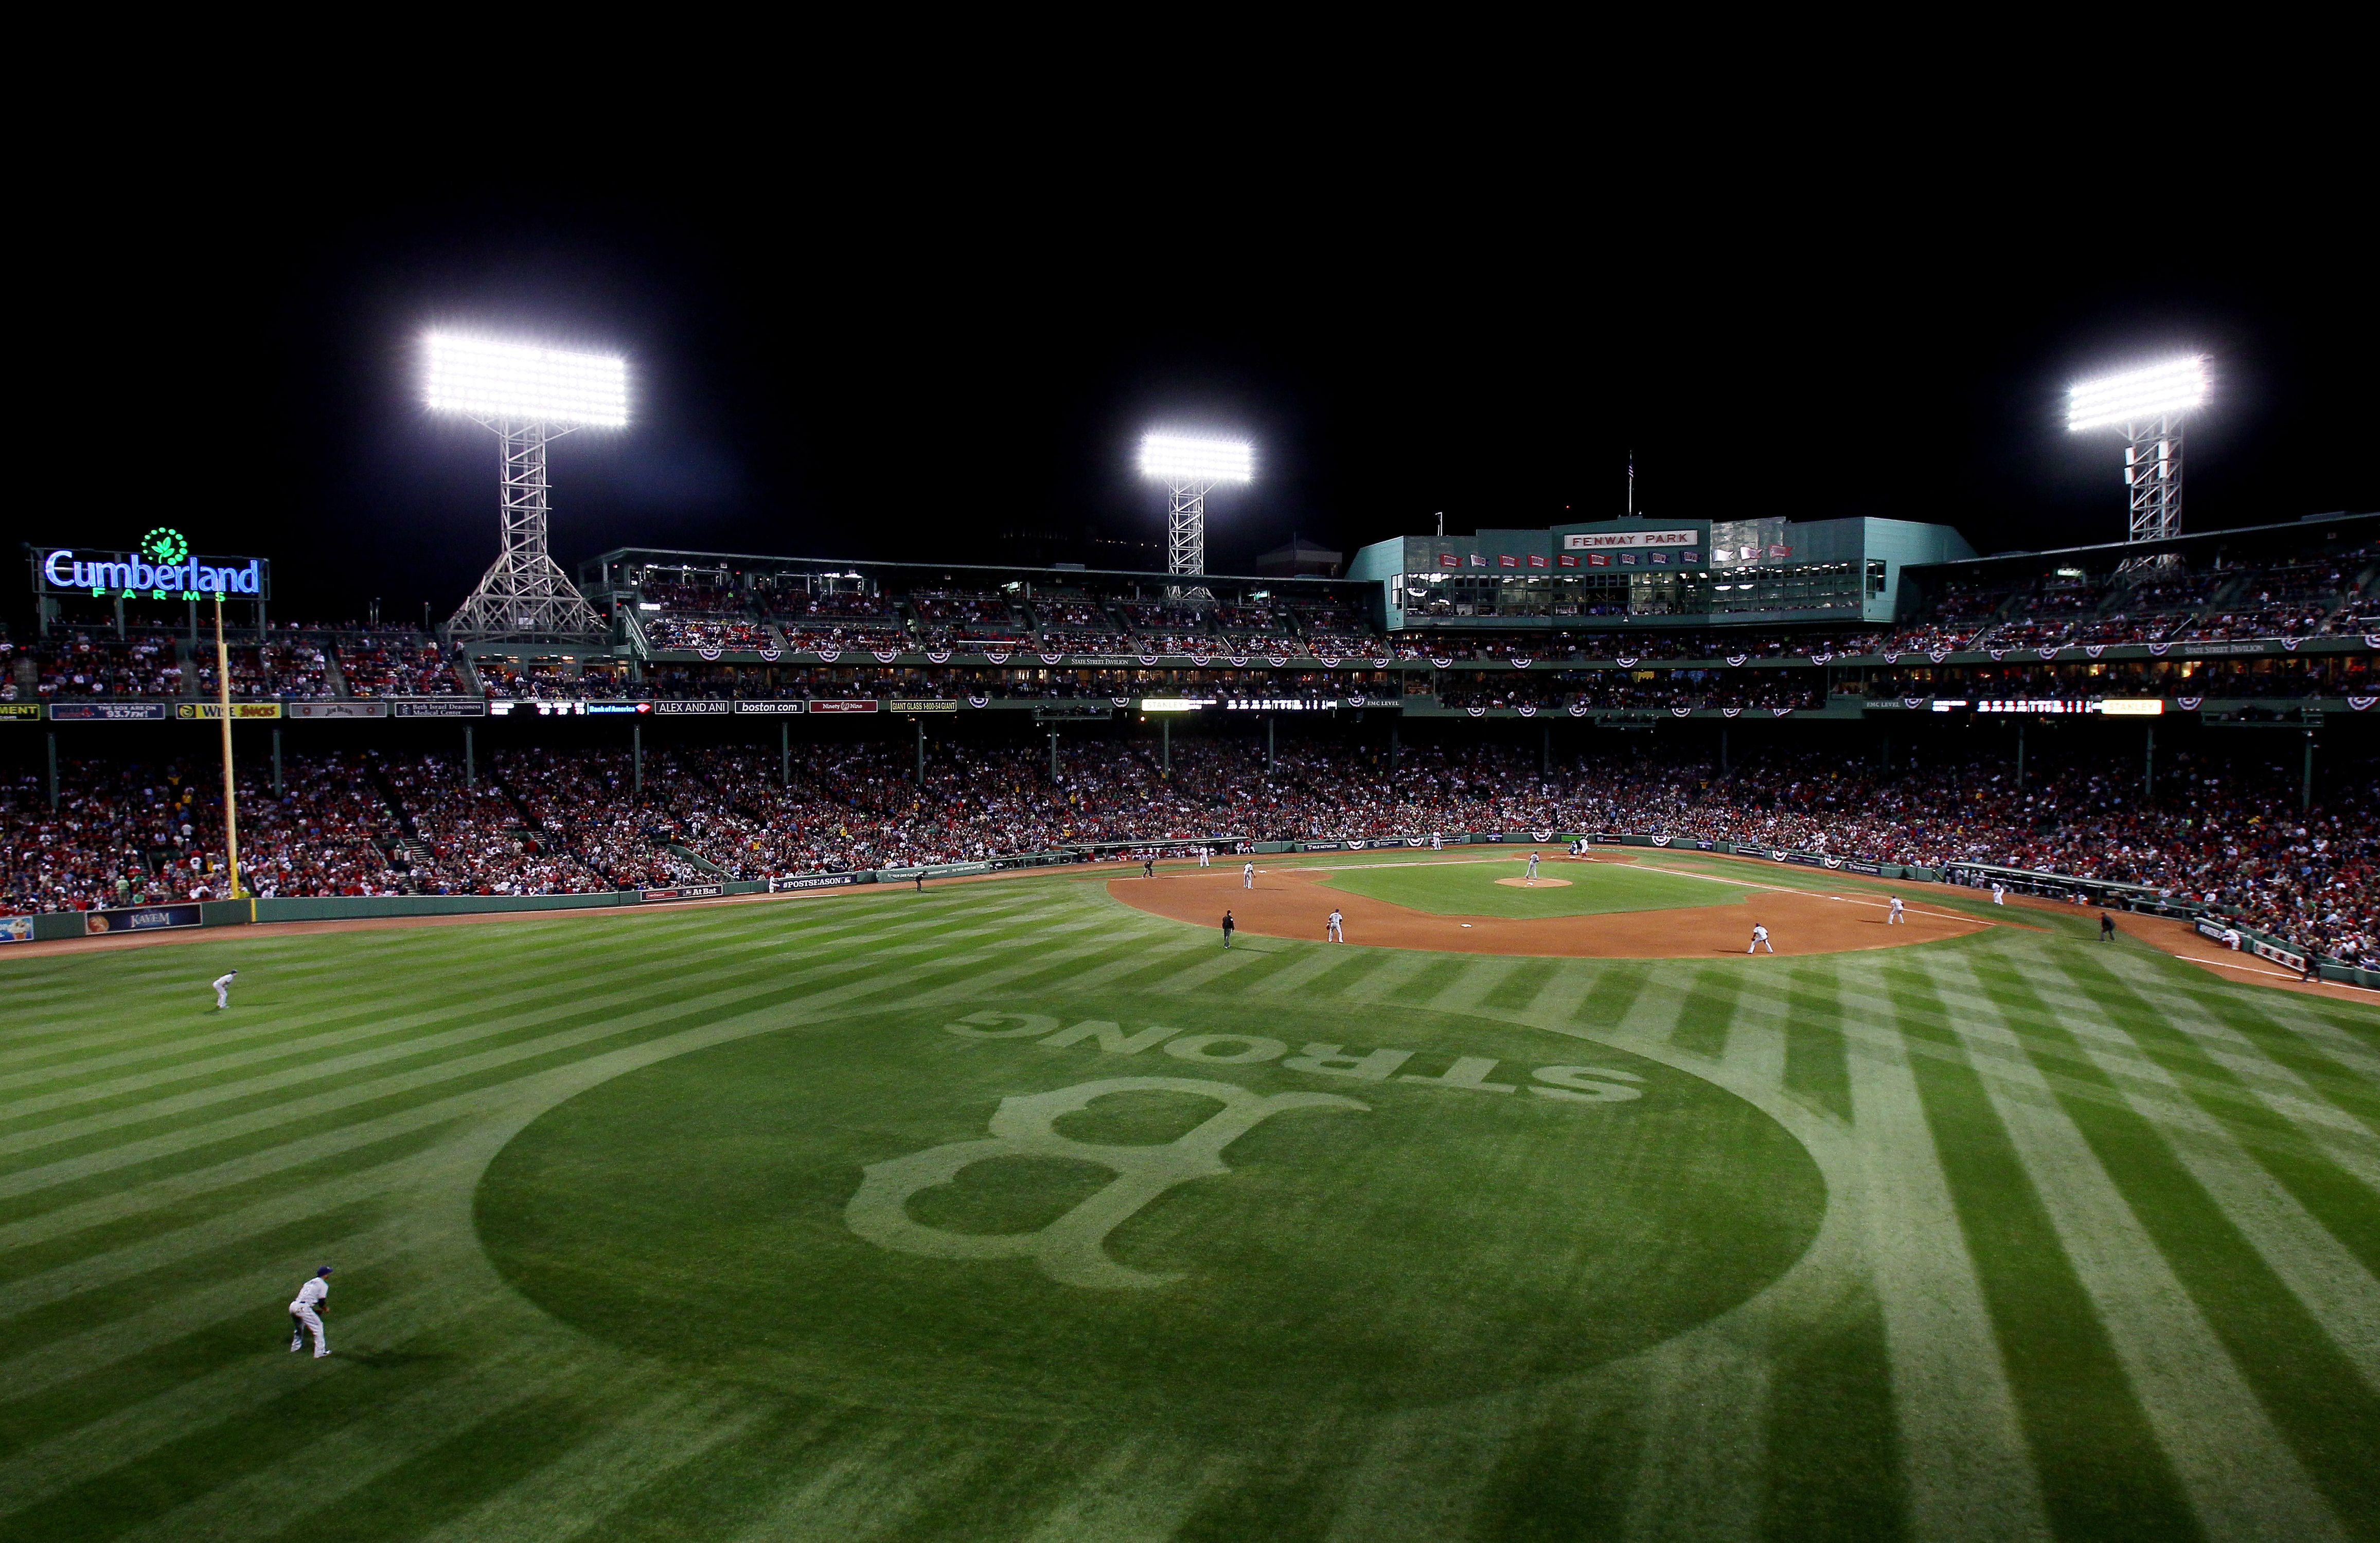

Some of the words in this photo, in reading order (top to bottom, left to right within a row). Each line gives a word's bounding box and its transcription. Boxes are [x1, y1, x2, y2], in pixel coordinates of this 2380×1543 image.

[1572, 535, 1635, 546] FENWAY
[1646, 533, 1688, 544] PARK
[45, 550, 259, 593] Cumberland
[92, 587, 226, 602] FARMS
[2230, 644, 2263, 653] PAVILION
[203, 705, 235, 717] WIE
[659, 703, 683, 712] ALEX
[685, 703, 706, 712] AND
[708, 703, 725, 712] ANI
[892, 702, 905, 710] GIANT
[783, 877, 841, 888] #POSTSEASON
